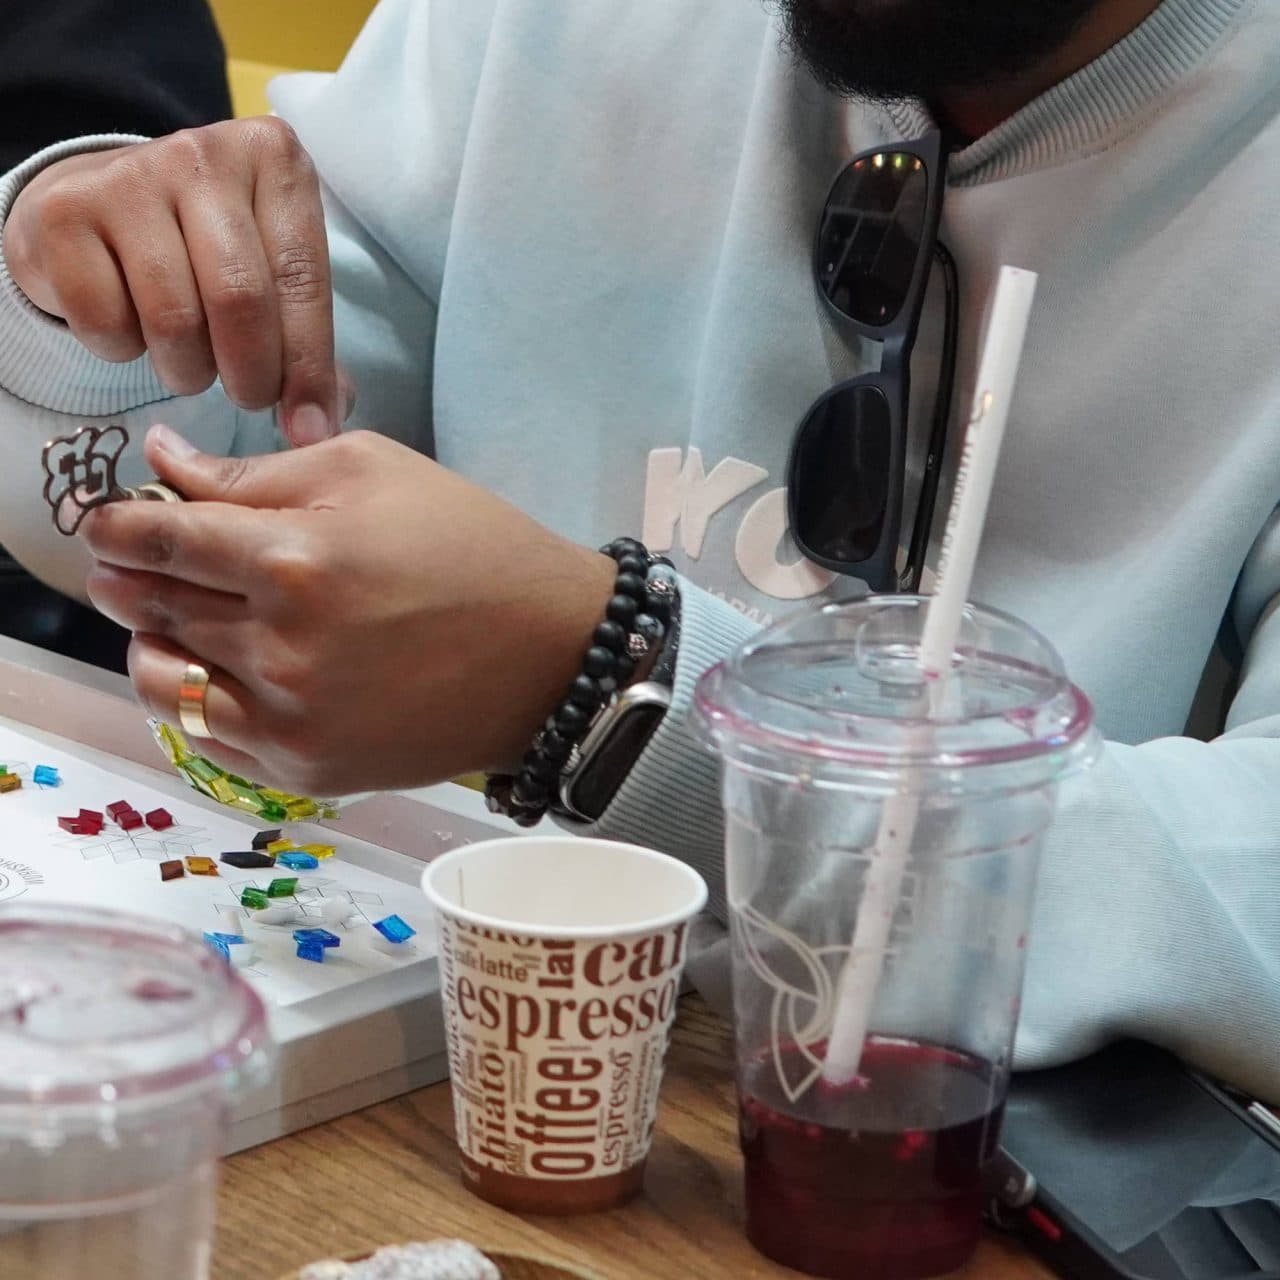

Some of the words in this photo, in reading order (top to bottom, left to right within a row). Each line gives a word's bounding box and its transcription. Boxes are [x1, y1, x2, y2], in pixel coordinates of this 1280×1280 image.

[457, 975, 676, 1054] espresso
[479, 951, 528, 983] latte
[478, 1052, 506, 1169] hiato
[602, 1051, 633, 1167] espresso
